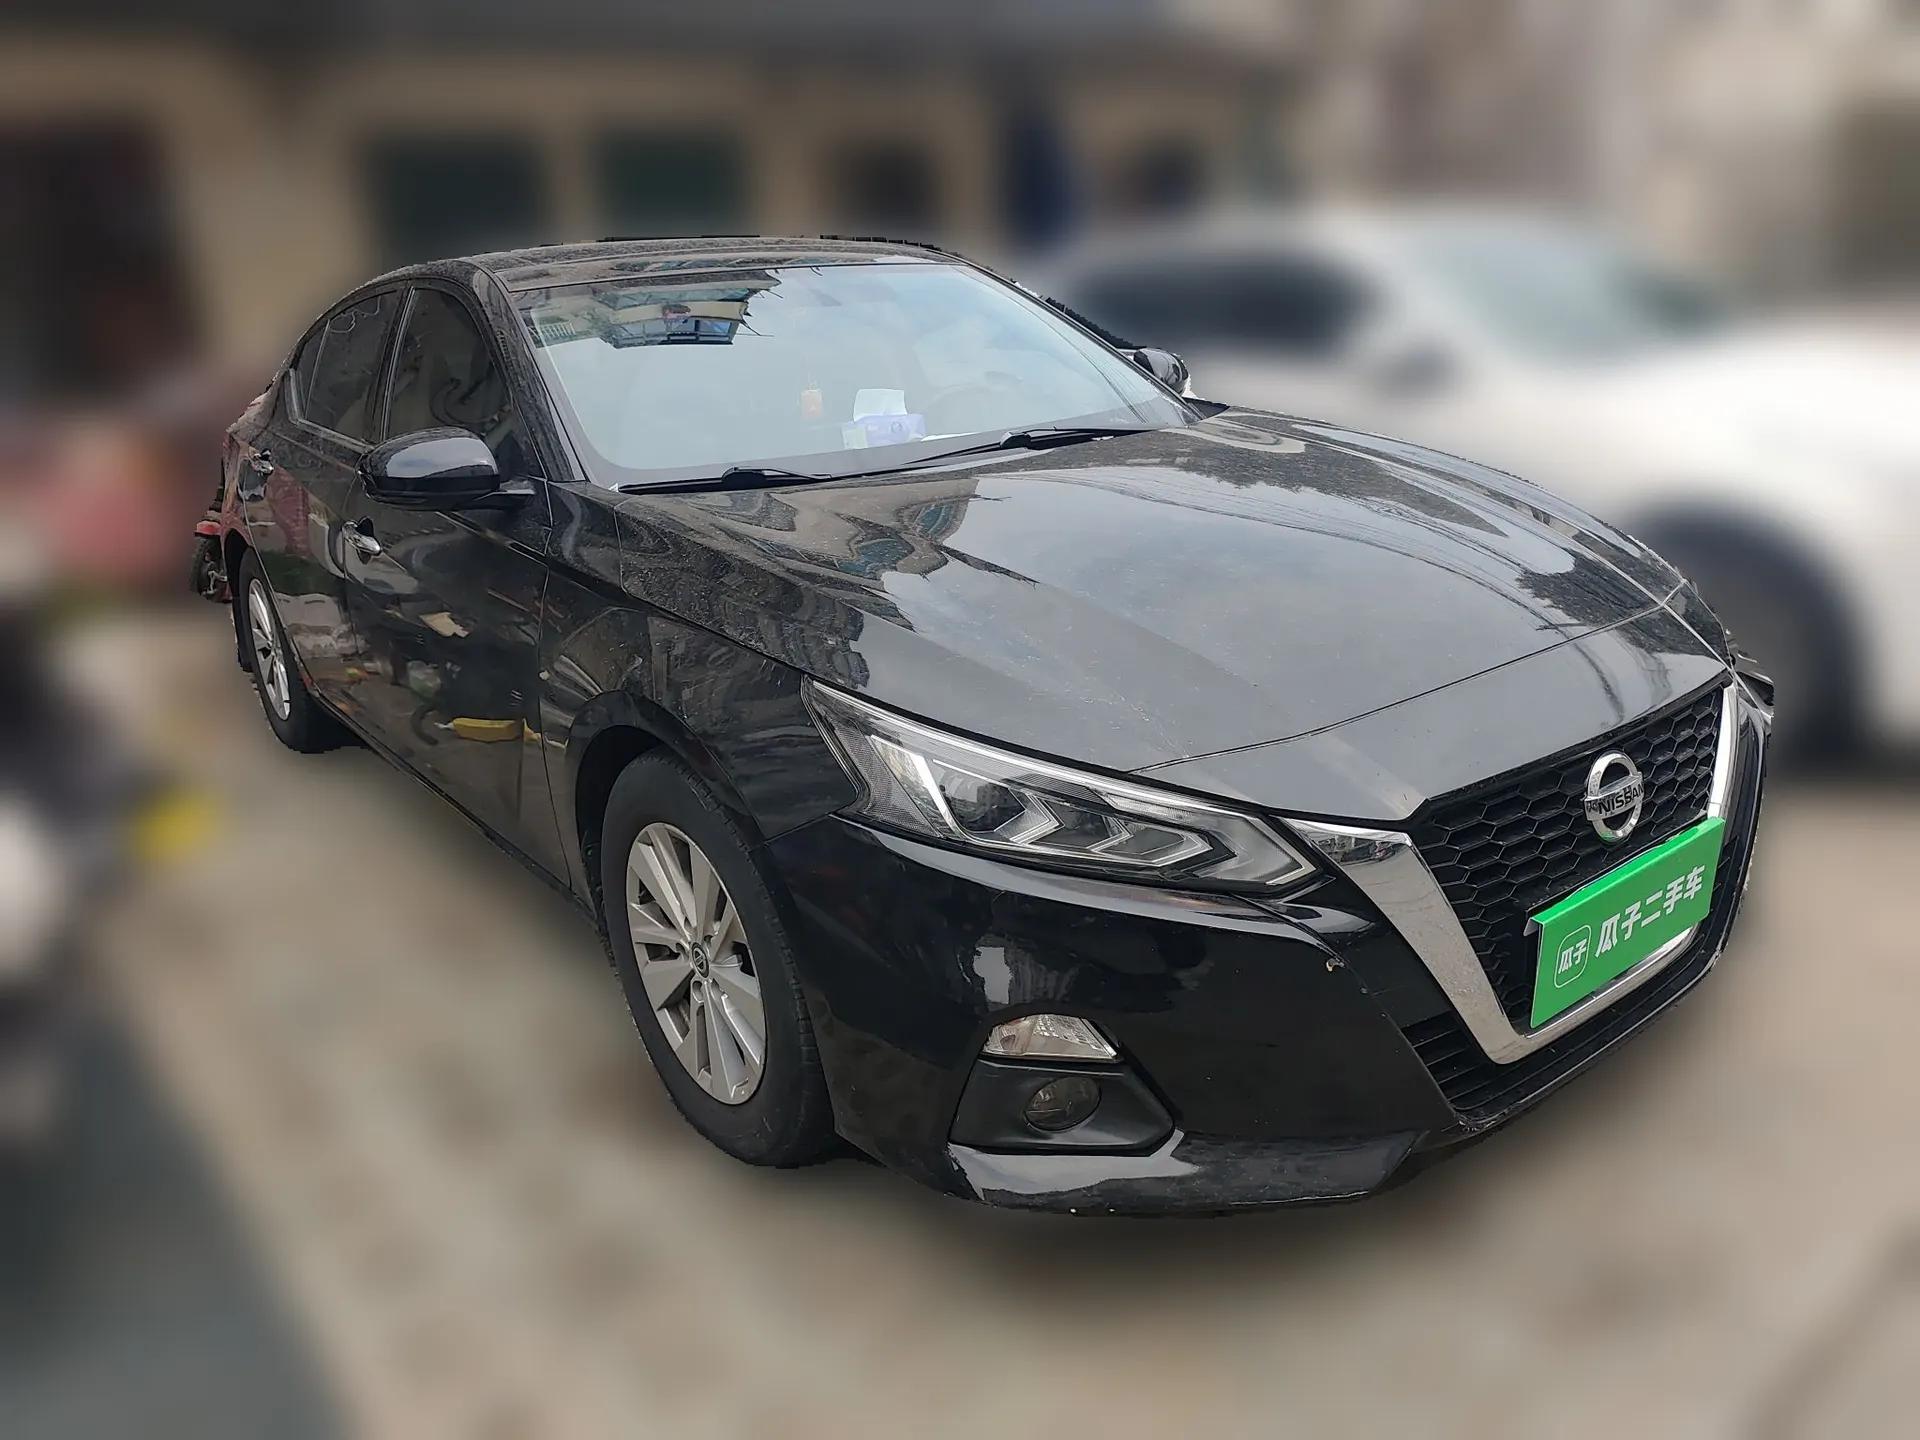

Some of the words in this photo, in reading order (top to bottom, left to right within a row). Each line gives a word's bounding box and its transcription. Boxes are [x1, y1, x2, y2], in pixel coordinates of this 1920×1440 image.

[1598, 783, 1644, 815] NISSAN
[1594, 865, 1705, 958] 瓜子二手车
[1558, 938, 1588, 975] 瓜子
